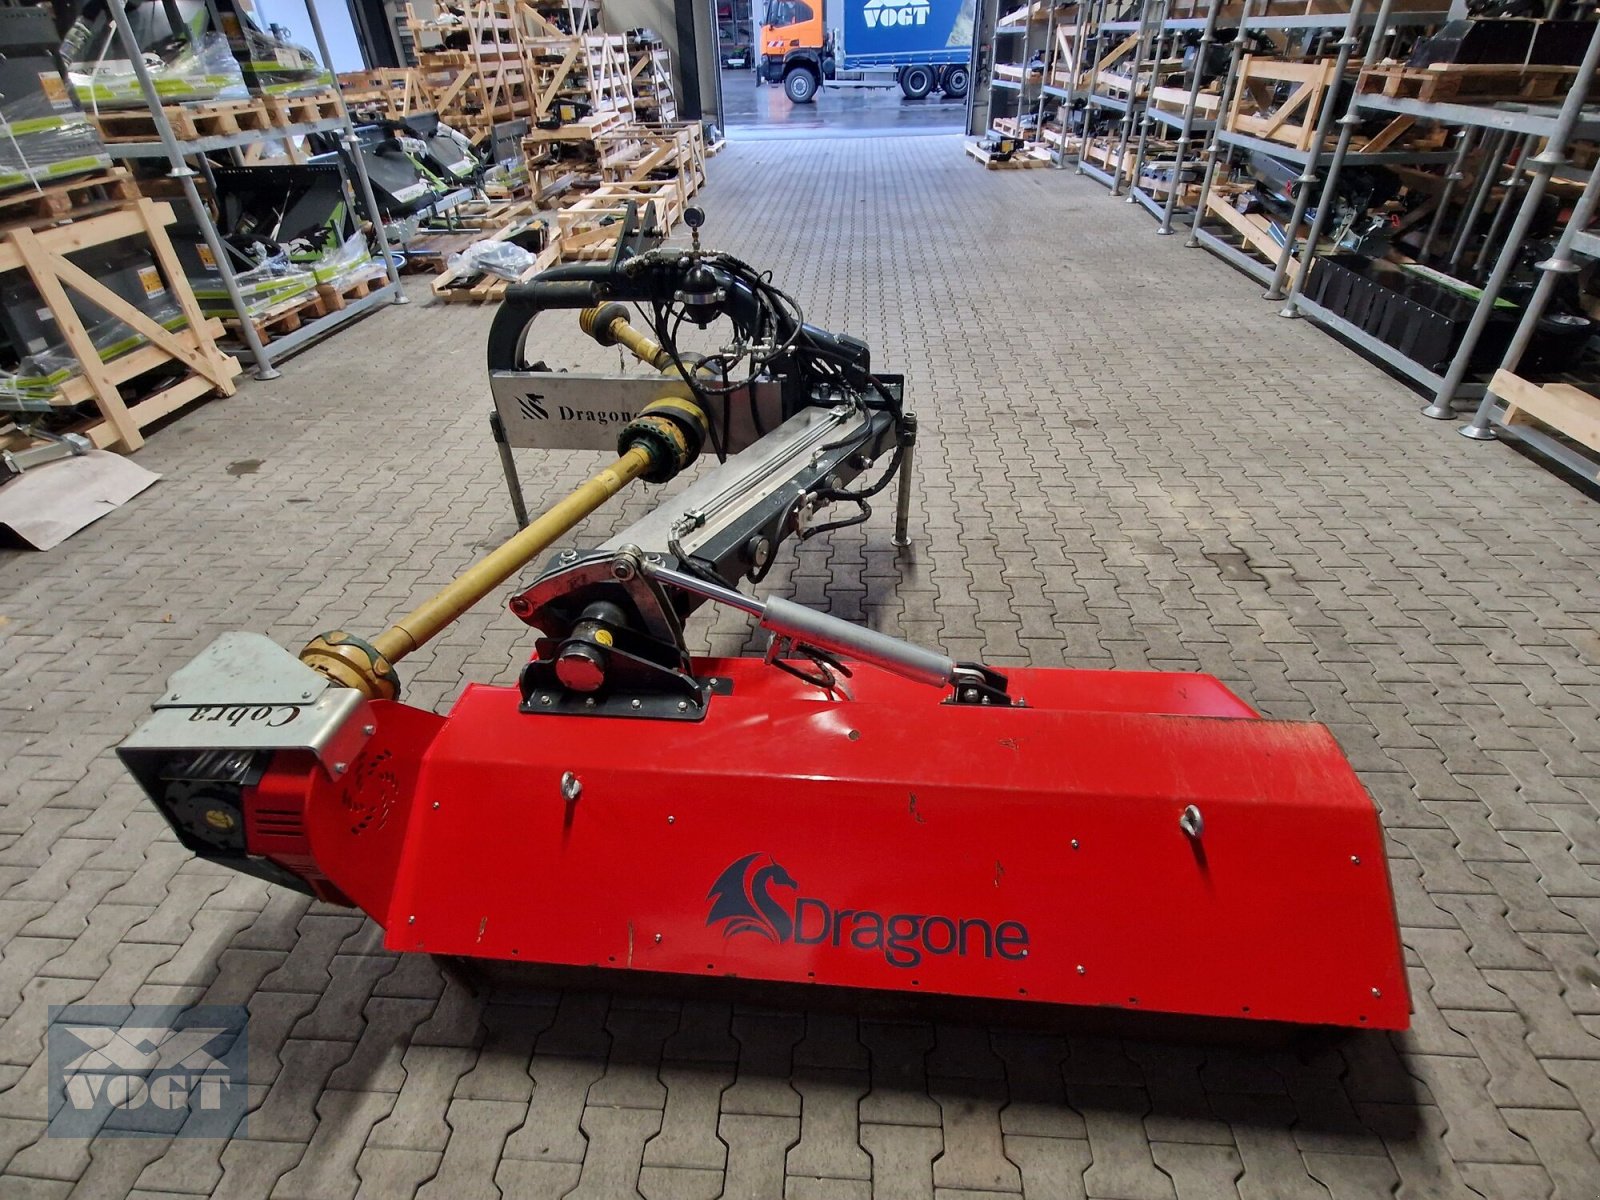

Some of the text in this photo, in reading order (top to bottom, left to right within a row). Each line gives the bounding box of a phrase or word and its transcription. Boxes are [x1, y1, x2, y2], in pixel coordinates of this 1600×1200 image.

[863, 6, 930, 28] VOGT
[188, 706, 302, 728] Cobra
[793, 897, 1030, 969] Dragone
